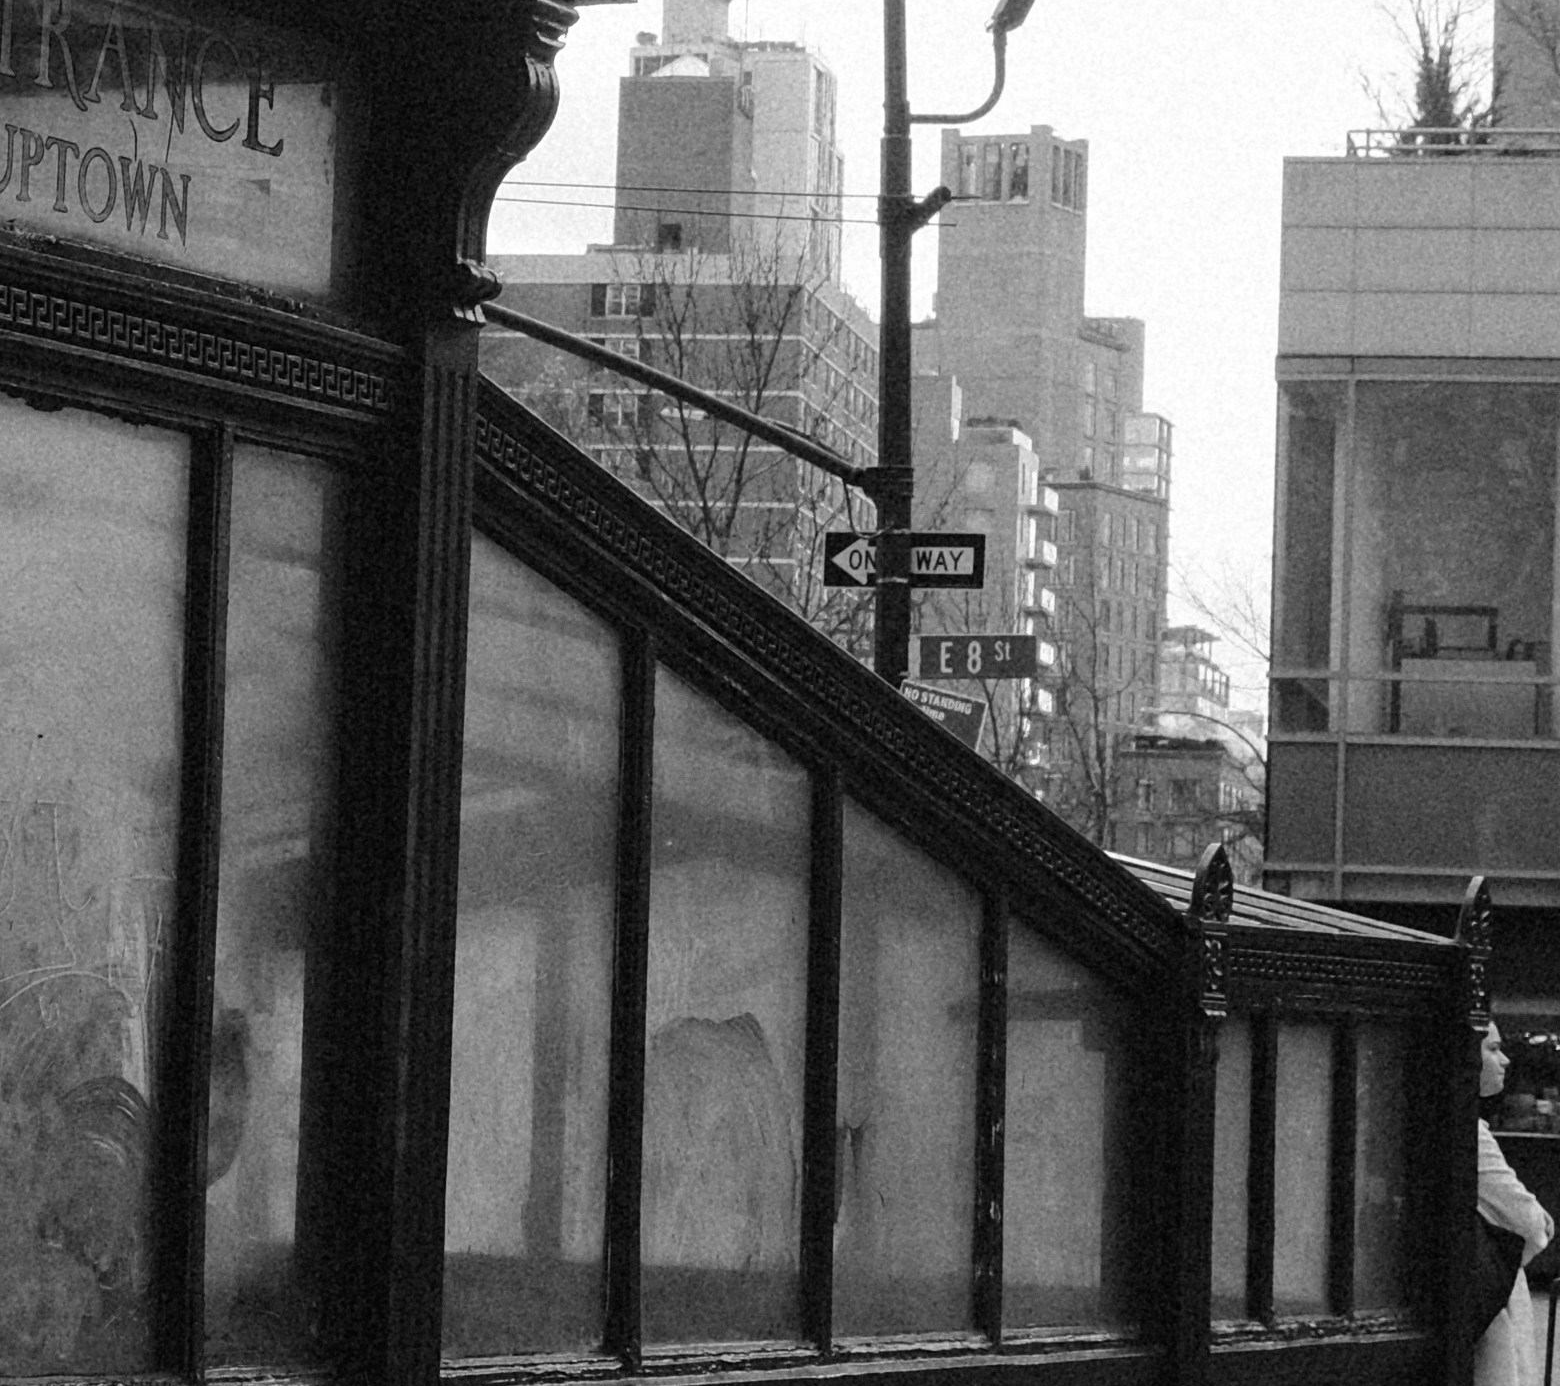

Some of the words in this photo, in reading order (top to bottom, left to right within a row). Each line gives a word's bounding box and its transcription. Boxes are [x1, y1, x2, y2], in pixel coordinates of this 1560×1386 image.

[849, 549, 877, 570] ON
[916, 550, 964, 571] WAY
[940, 641, 953, 674] E
[967, 640, 982, 674] 8
[994, 640, 1011, 662] St
[903, 686, 919, 700] NO
[920, 691, 972, 715] STANDING
